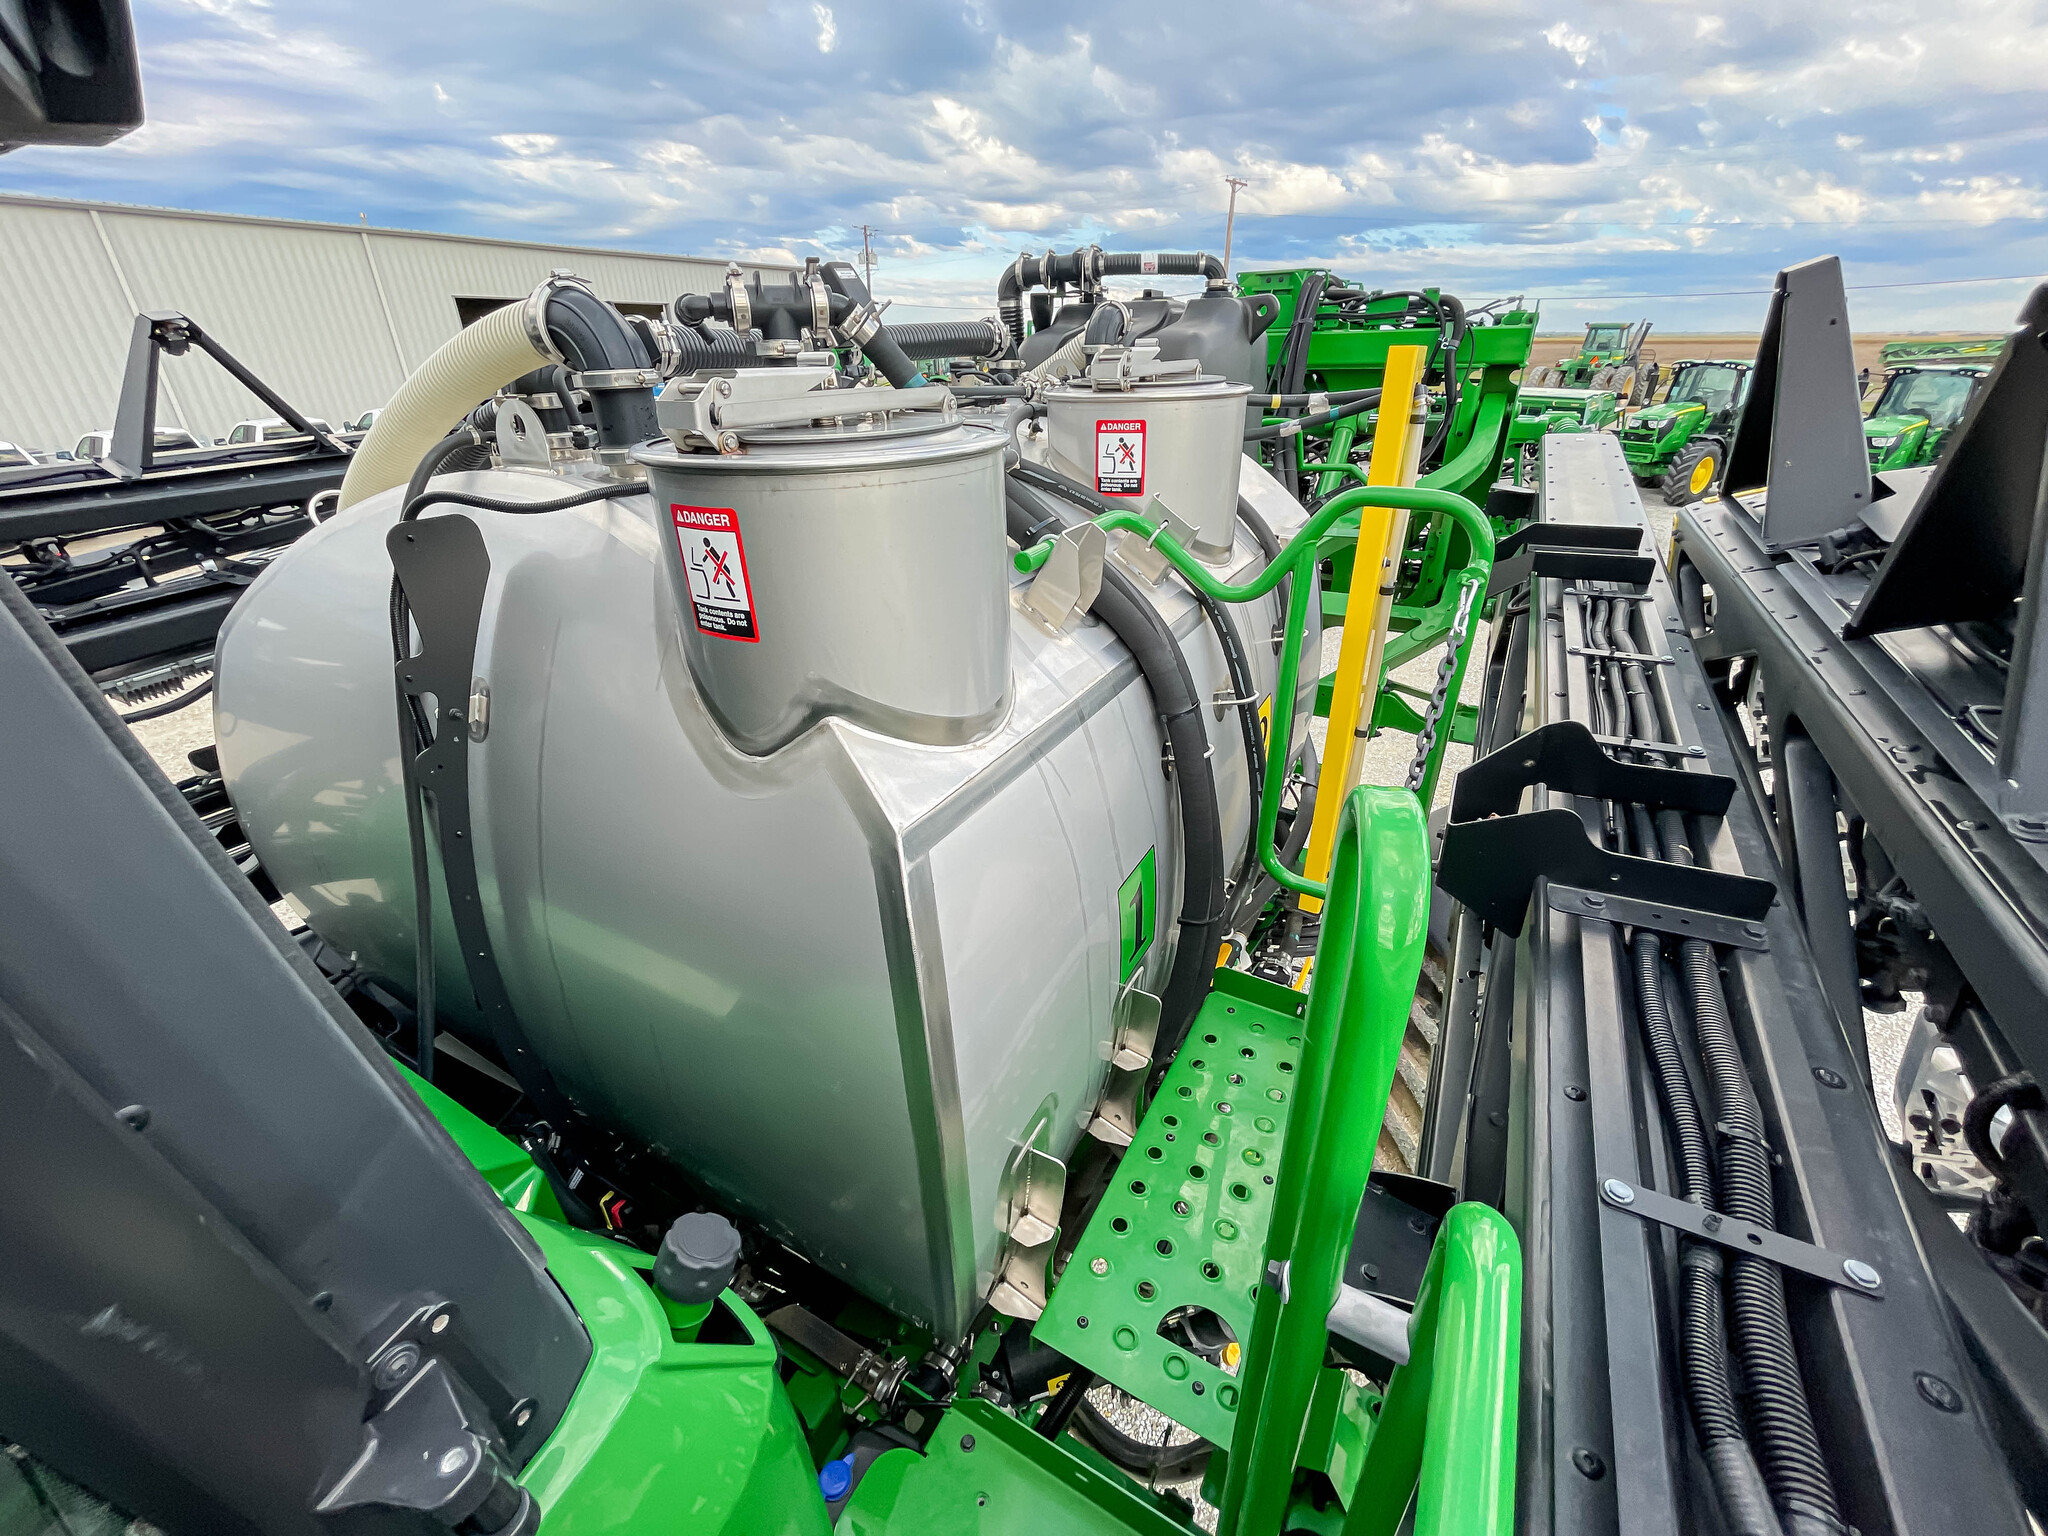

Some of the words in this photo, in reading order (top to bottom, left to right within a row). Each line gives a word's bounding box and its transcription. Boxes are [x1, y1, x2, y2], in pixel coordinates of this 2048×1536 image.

[1107, 423, 1141, 431] DANGER
[683, 510, 731, 527] DANGER
[696, 604, 709, 613] Tank
[709, 609, 733, 618] contents
[699, 613, 726, 624] poisonous.
[700, 620, 712, 628] enter
[713, 623, 727, 631] tank.
[1129, 881, 1147, 963] 1
